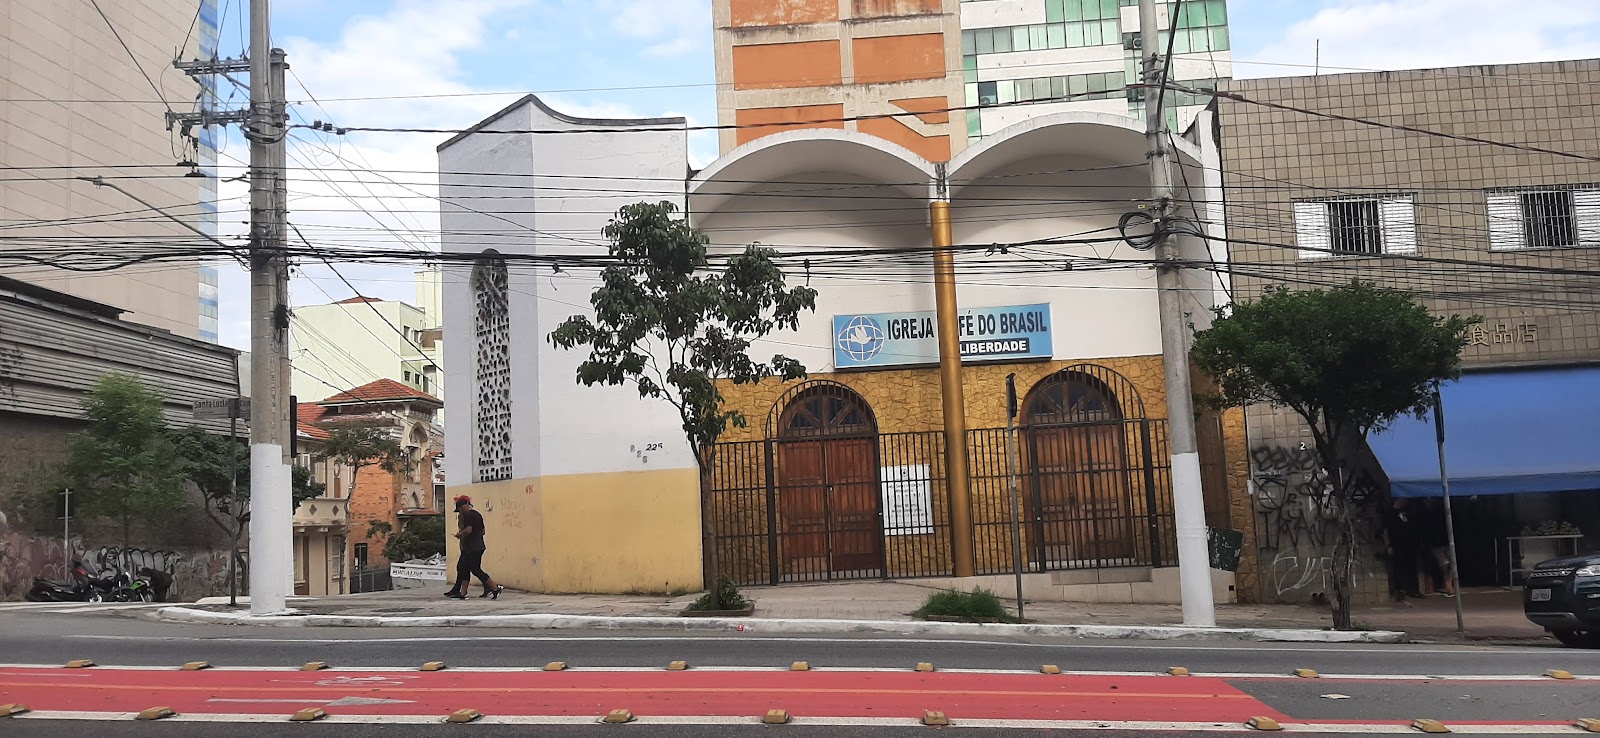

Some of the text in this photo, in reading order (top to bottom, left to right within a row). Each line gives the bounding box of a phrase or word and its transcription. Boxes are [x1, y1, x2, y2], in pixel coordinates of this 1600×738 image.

[887, 310, 1048, 340] IGREJA FÉ DO BRASIL
[960, 341, 1026, 354] LIBERDADE
[194, 399, 229, 409] Santa Luzia
